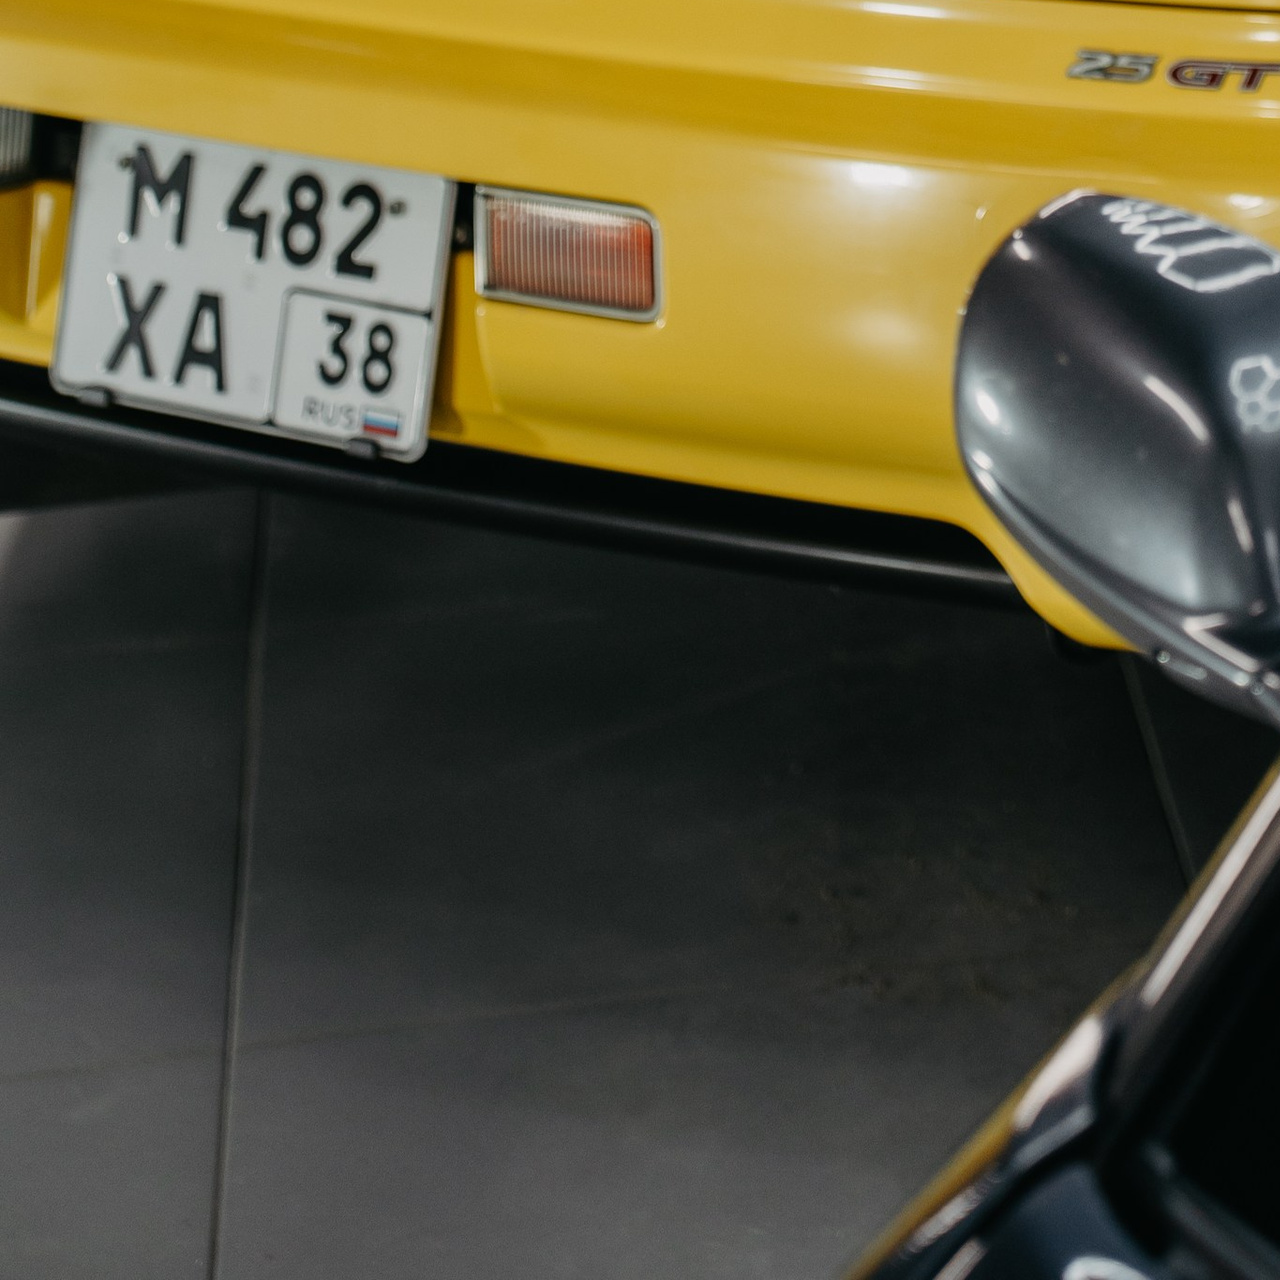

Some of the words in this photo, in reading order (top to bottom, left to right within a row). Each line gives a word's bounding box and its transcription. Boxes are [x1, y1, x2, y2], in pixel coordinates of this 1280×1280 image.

[1066, 48, 1159, 82] 25
[130, 144, 193, 244] M
[226, 164, 381, 279] 482
[107, 275, 226, 393] XA
[319, 313, 394, 393] 38
[304, 398, 356, 429] RUS
